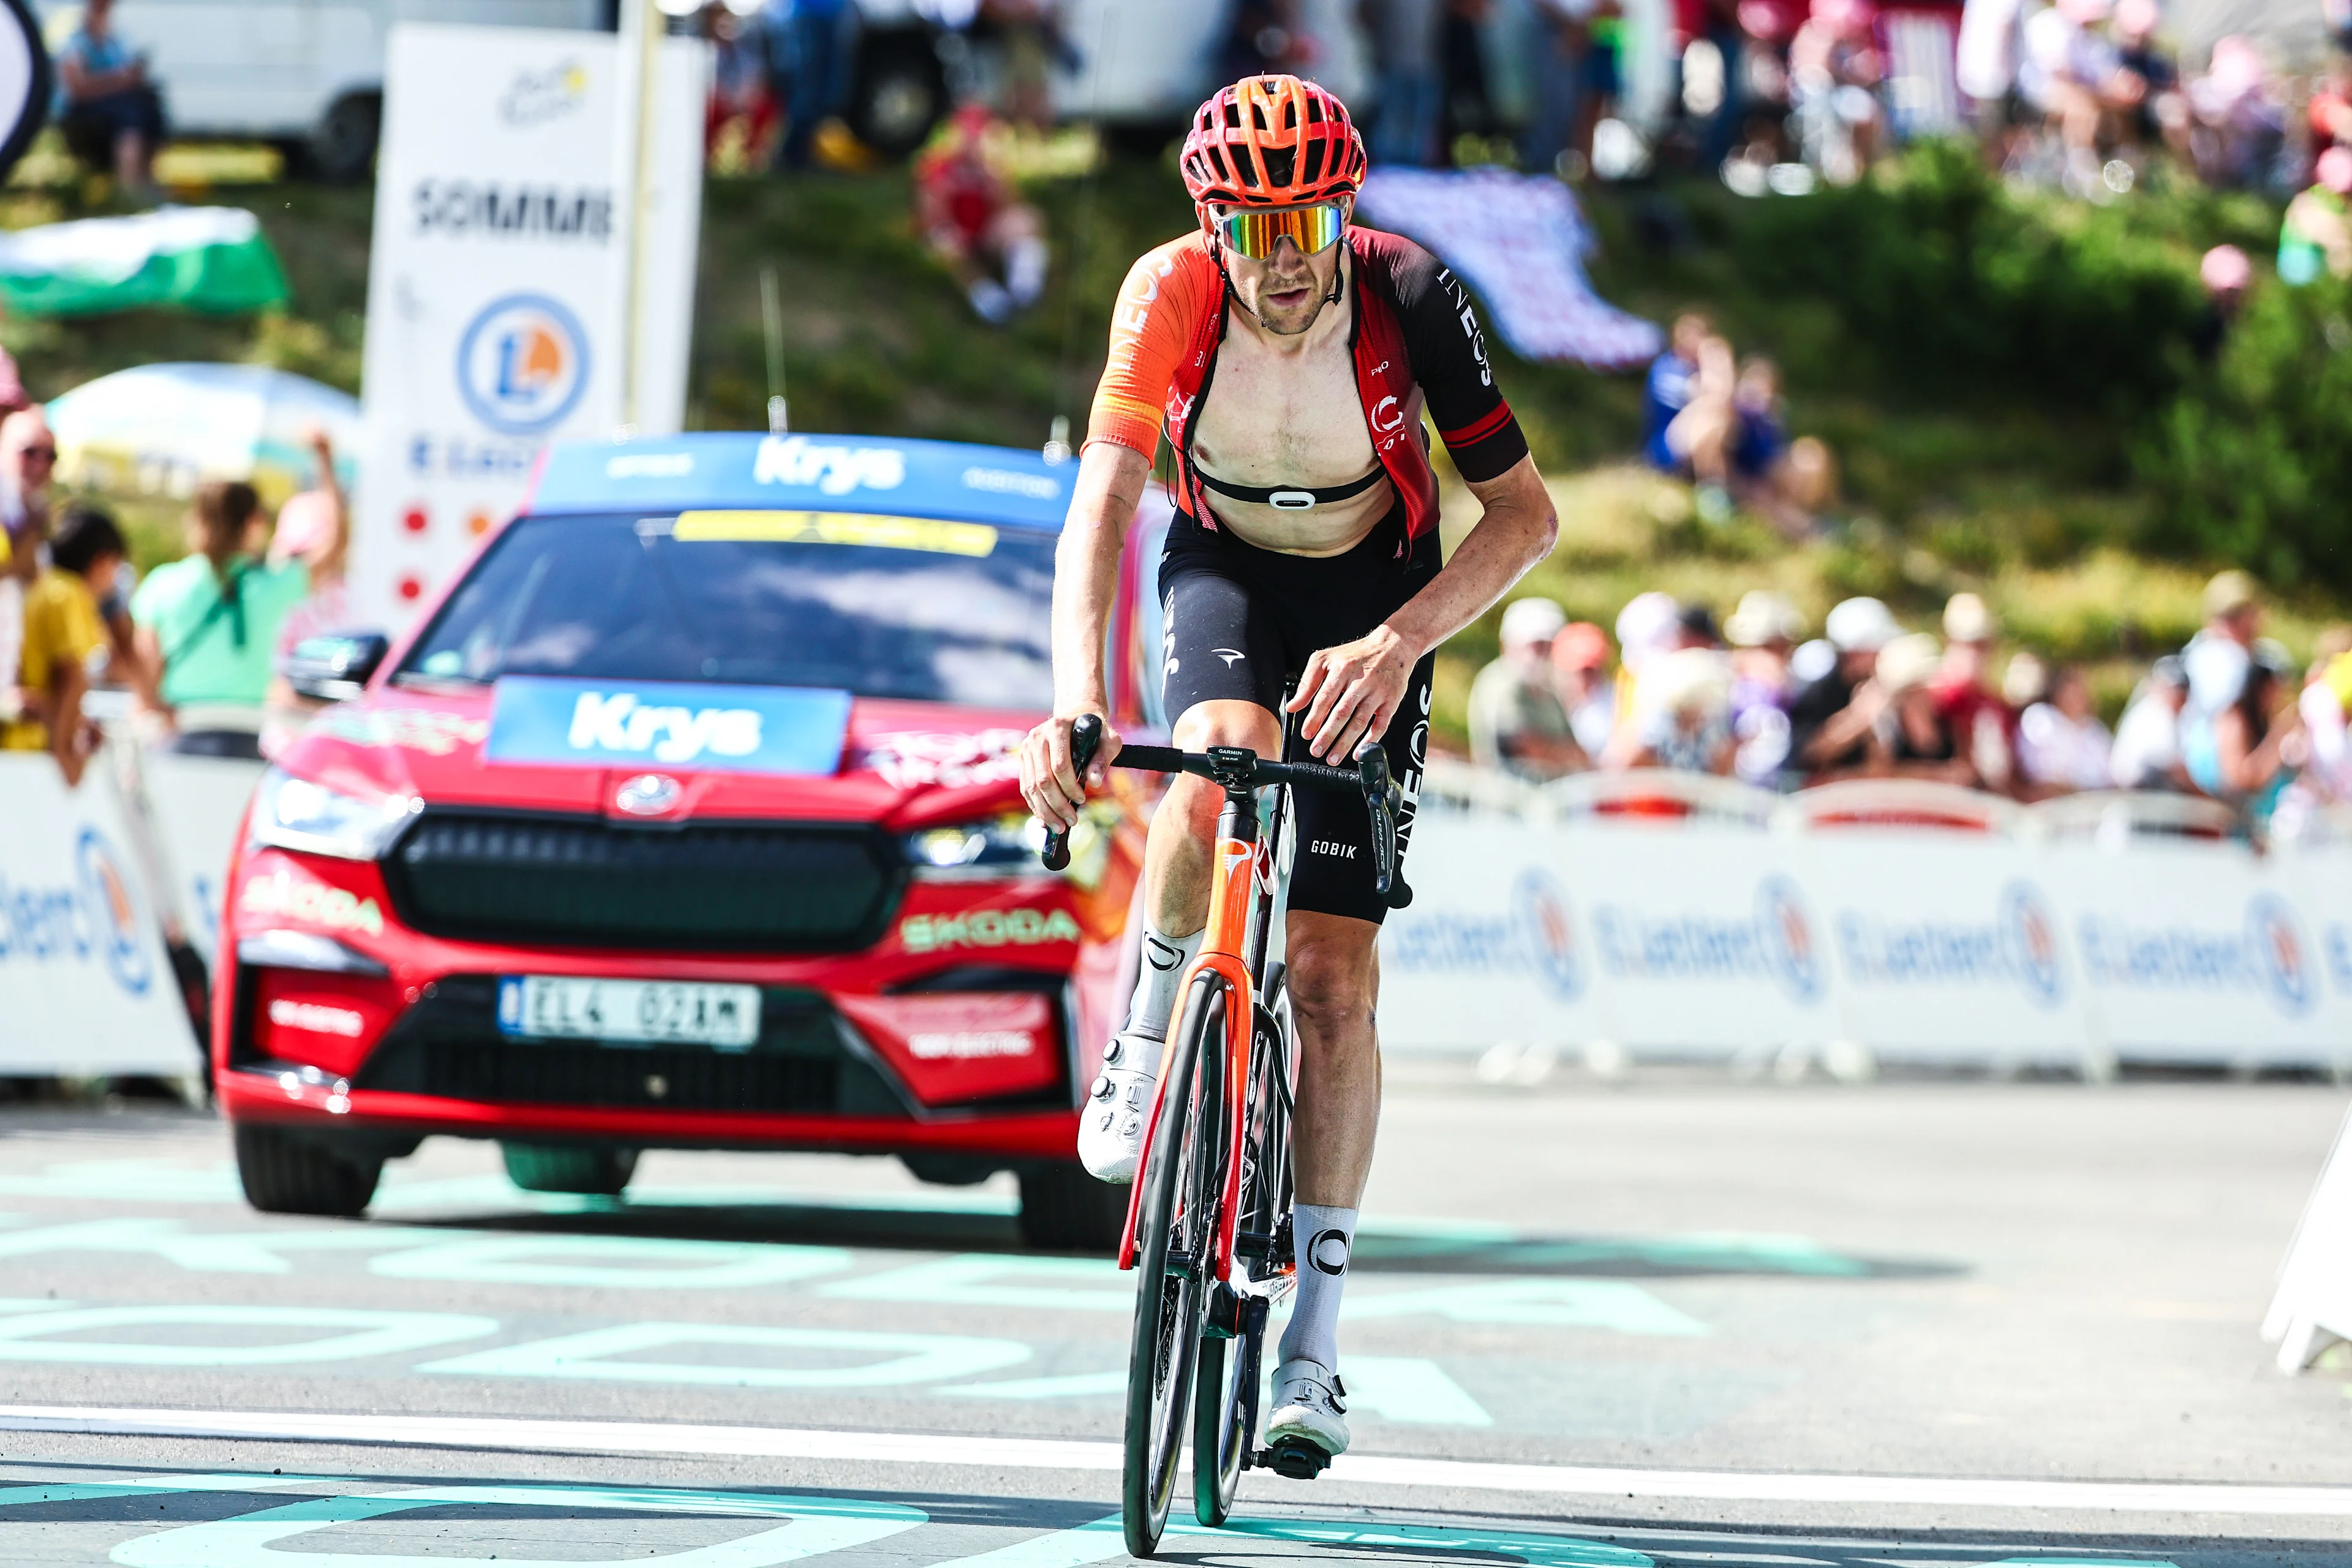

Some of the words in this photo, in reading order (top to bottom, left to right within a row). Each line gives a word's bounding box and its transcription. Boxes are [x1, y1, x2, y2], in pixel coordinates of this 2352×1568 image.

[1107, 252, 1173, 372] INEOS
[1436, 268, 1491, 386] INEOS
[753, 435, 905, 496] Krys
[568, 691, 763, 763] Krys
[1311, 840, 1357, 859] GOBIK
[1376, 809, 1385, 870] DURA-ACE
